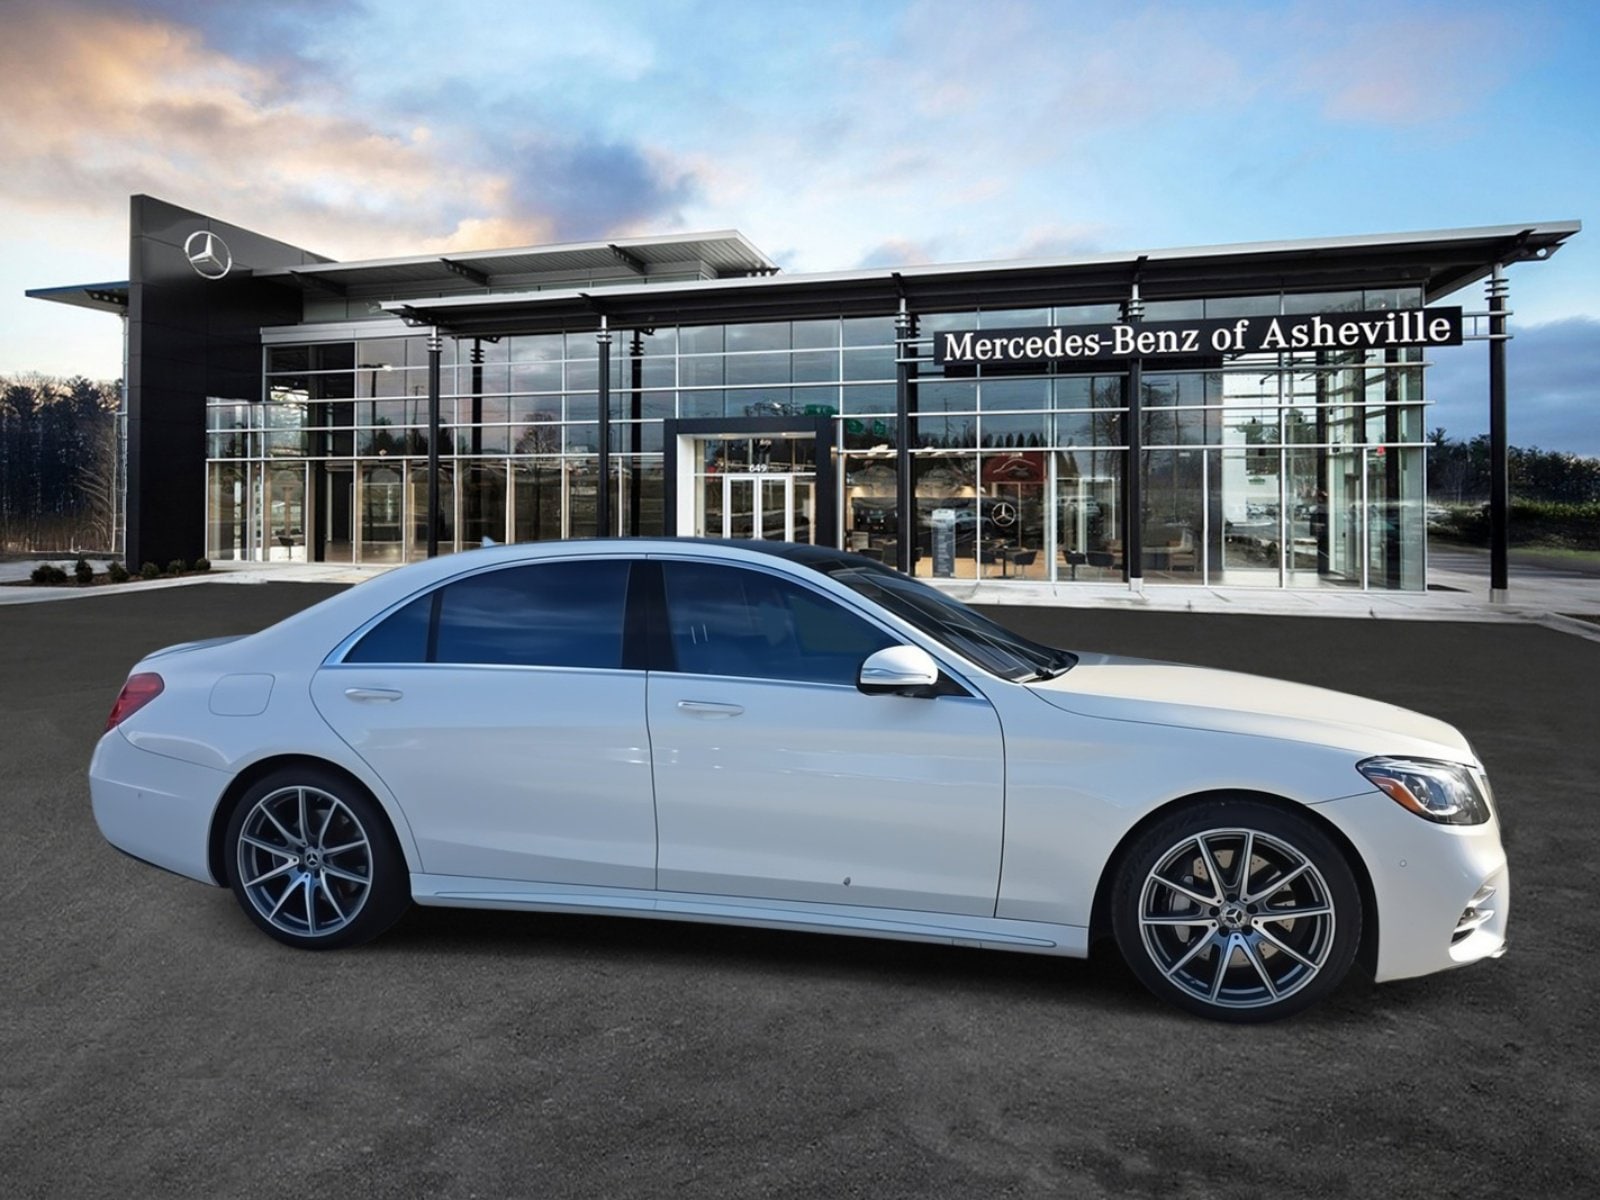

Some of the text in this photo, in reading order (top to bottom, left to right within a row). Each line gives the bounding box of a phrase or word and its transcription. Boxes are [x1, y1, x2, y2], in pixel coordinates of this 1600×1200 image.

[943, 311, 1451, 361] Mercedes-Benz of Asheville
